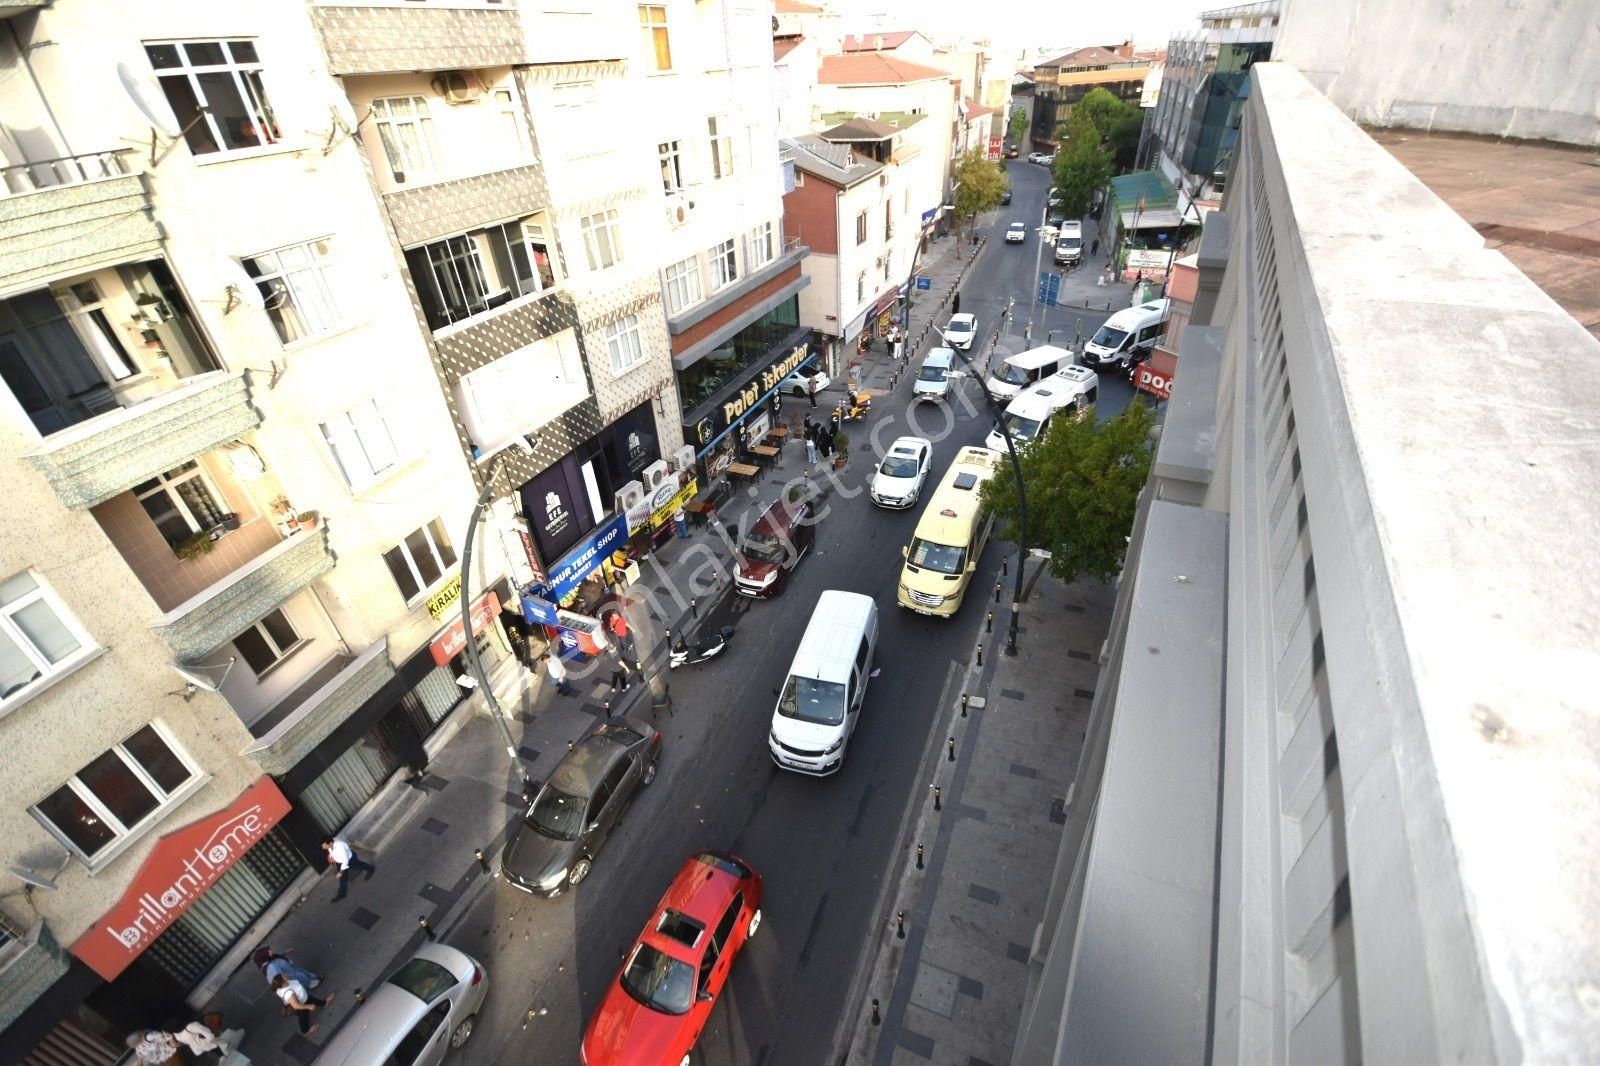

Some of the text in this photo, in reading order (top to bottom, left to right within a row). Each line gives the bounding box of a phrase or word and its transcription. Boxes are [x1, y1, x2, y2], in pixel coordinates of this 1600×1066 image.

[548, 507, 562, 521] EFE
[571, 546, 598, 571] TEKEL
[597, 528, 618, 550] SHOP
[569, 560, 592, 583] MARKET
